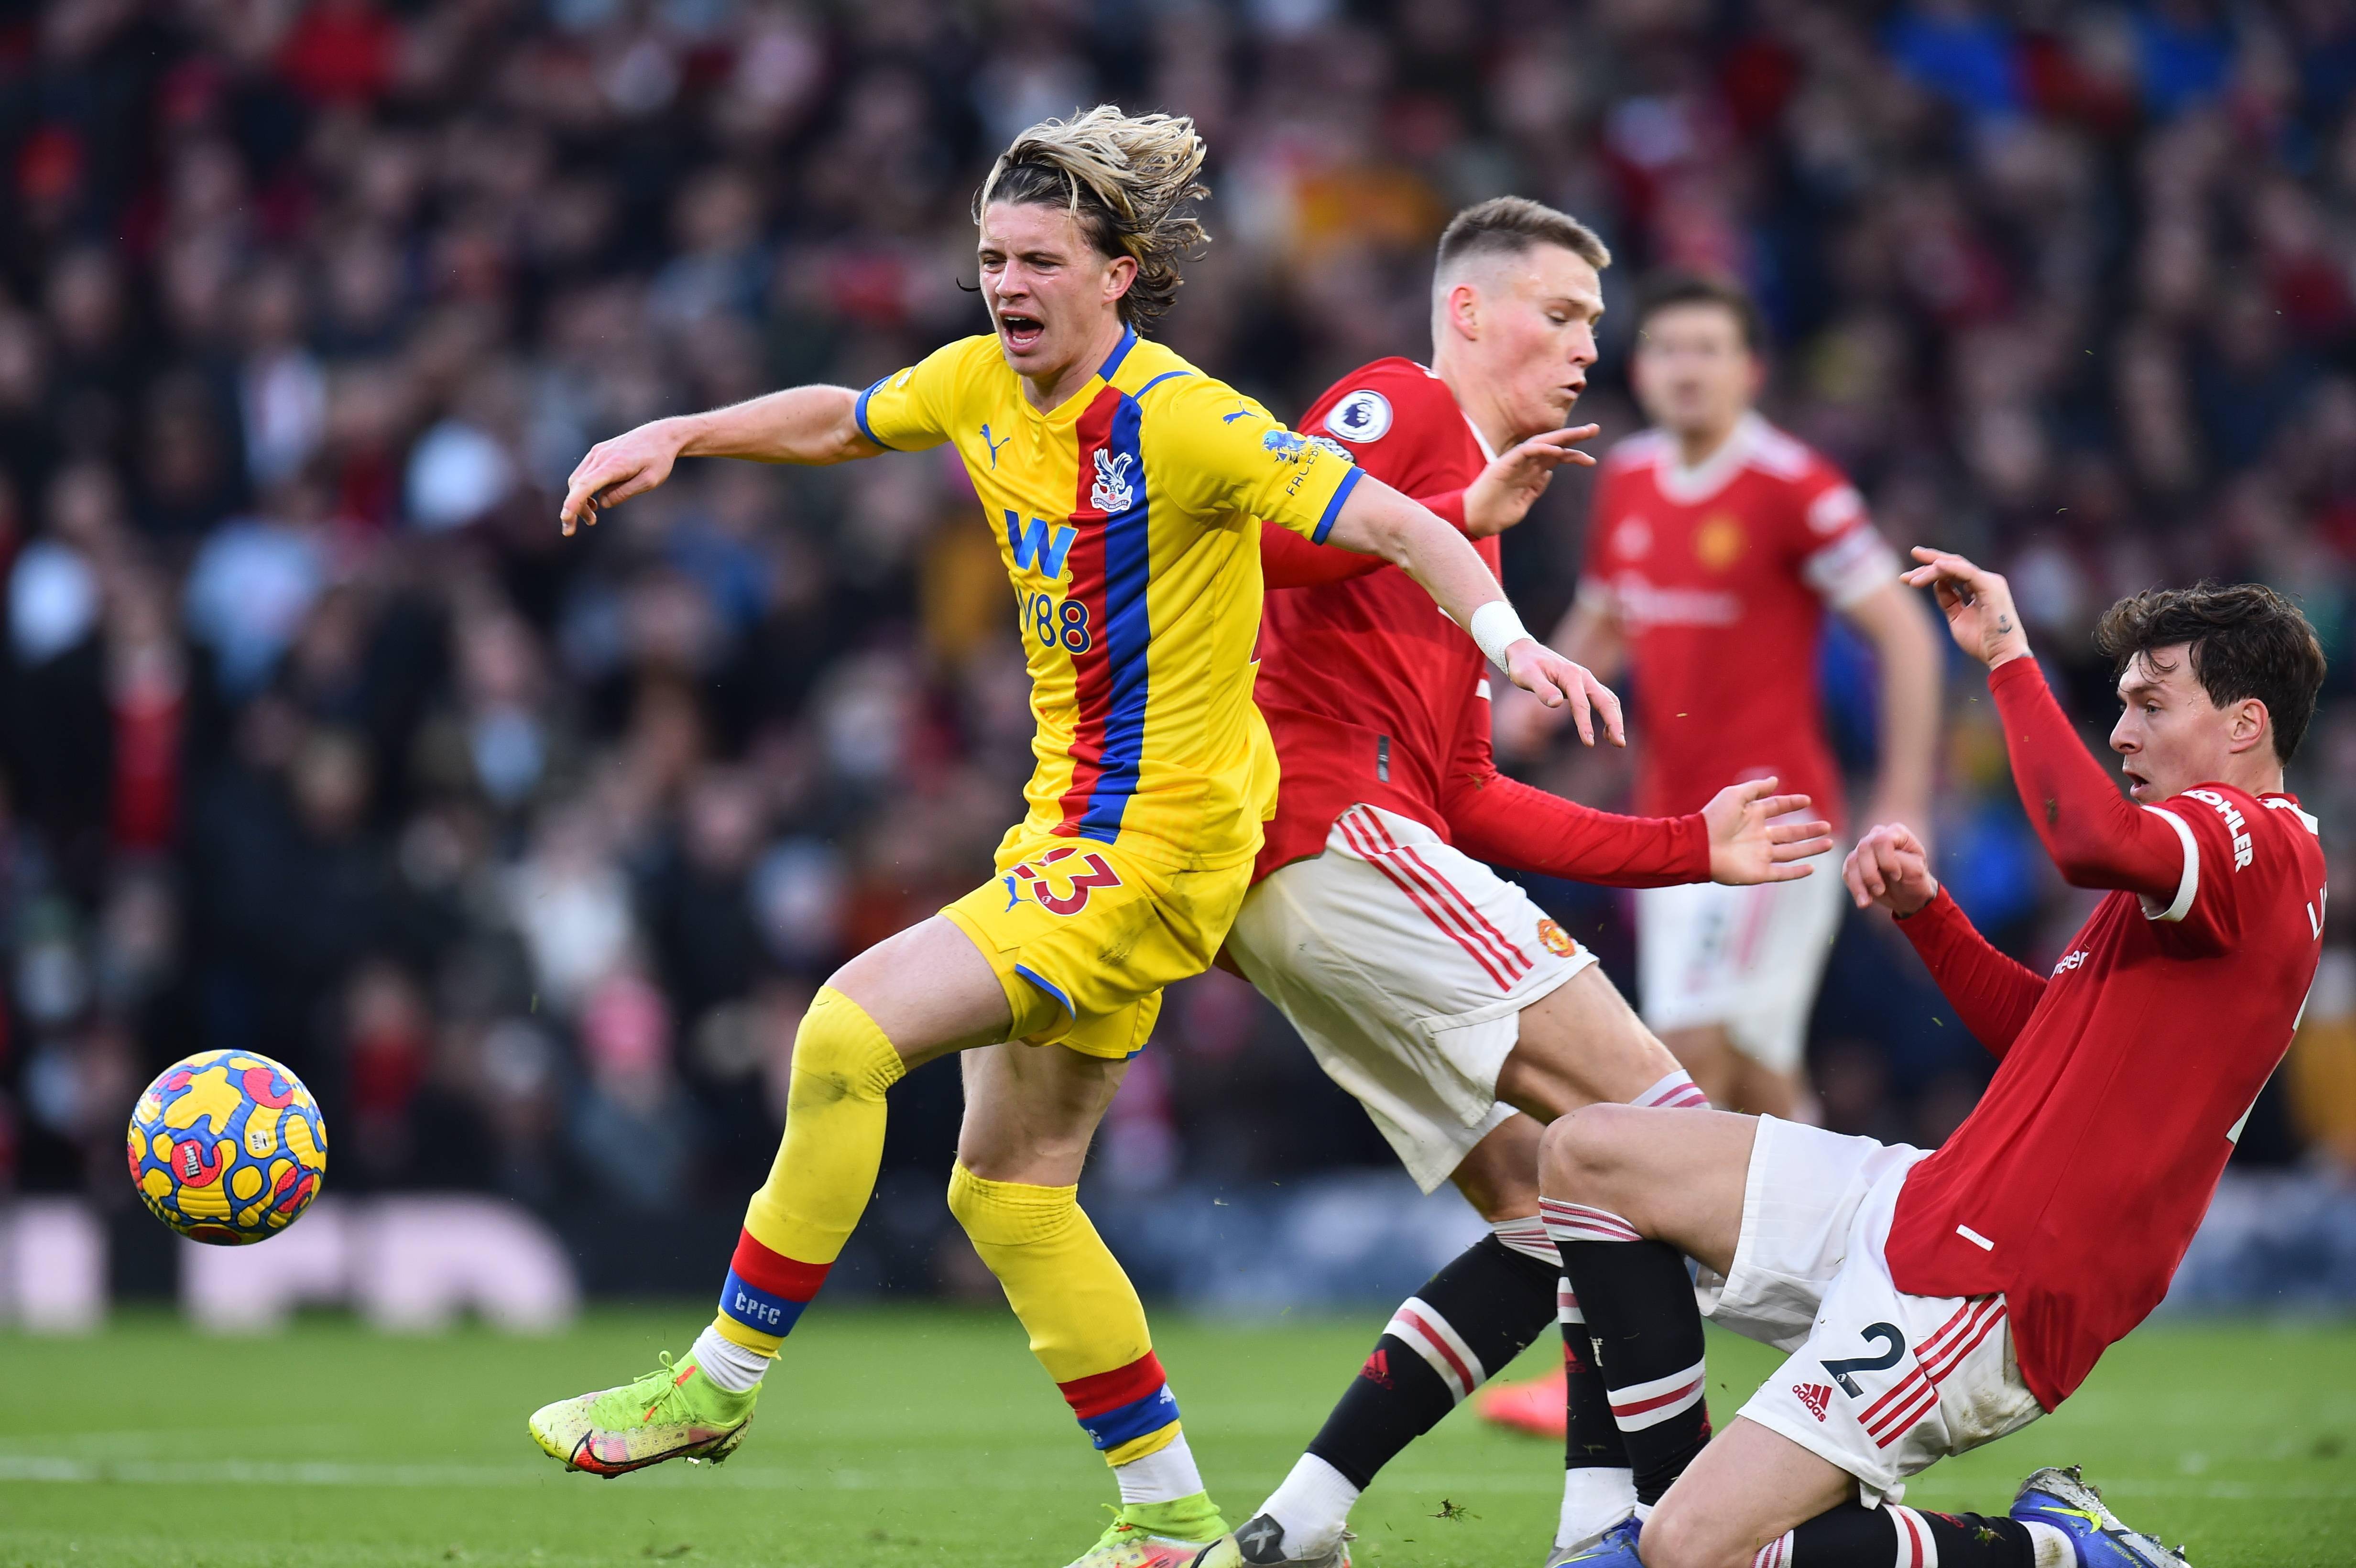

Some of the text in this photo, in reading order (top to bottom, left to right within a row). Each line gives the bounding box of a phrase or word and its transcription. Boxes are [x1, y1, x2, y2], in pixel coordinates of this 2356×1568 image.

[735, 1293, 781, 1325] CPFC
[1819, 1322, 1906, 1399] 2
[1792, 1384, 1826, 1423] adidas
